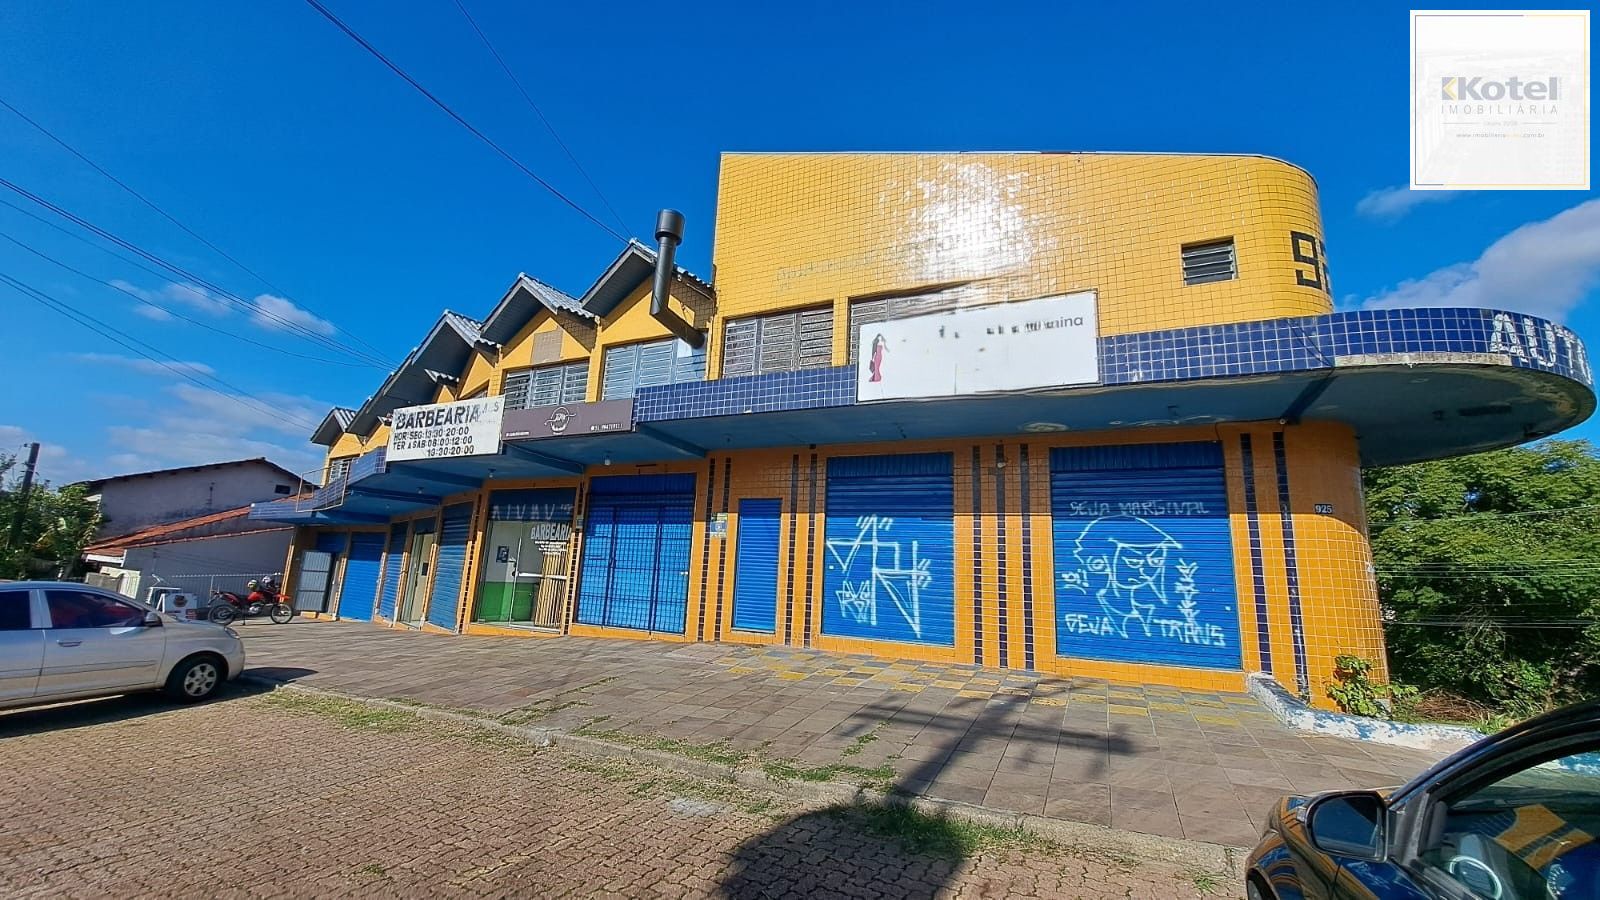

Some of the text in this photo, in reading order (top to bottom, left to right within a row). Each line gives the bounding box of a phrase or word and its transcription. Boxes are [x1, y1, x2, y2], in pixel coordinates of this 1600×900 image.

[396, 404, 480, 430] BARBEARIA
[393, 441, 406, 450] TER
[412, 440, 426, 449] SAB
[1069, 501, 1110, 516] SEJA
[1315, 504, 1333, 514] 925
